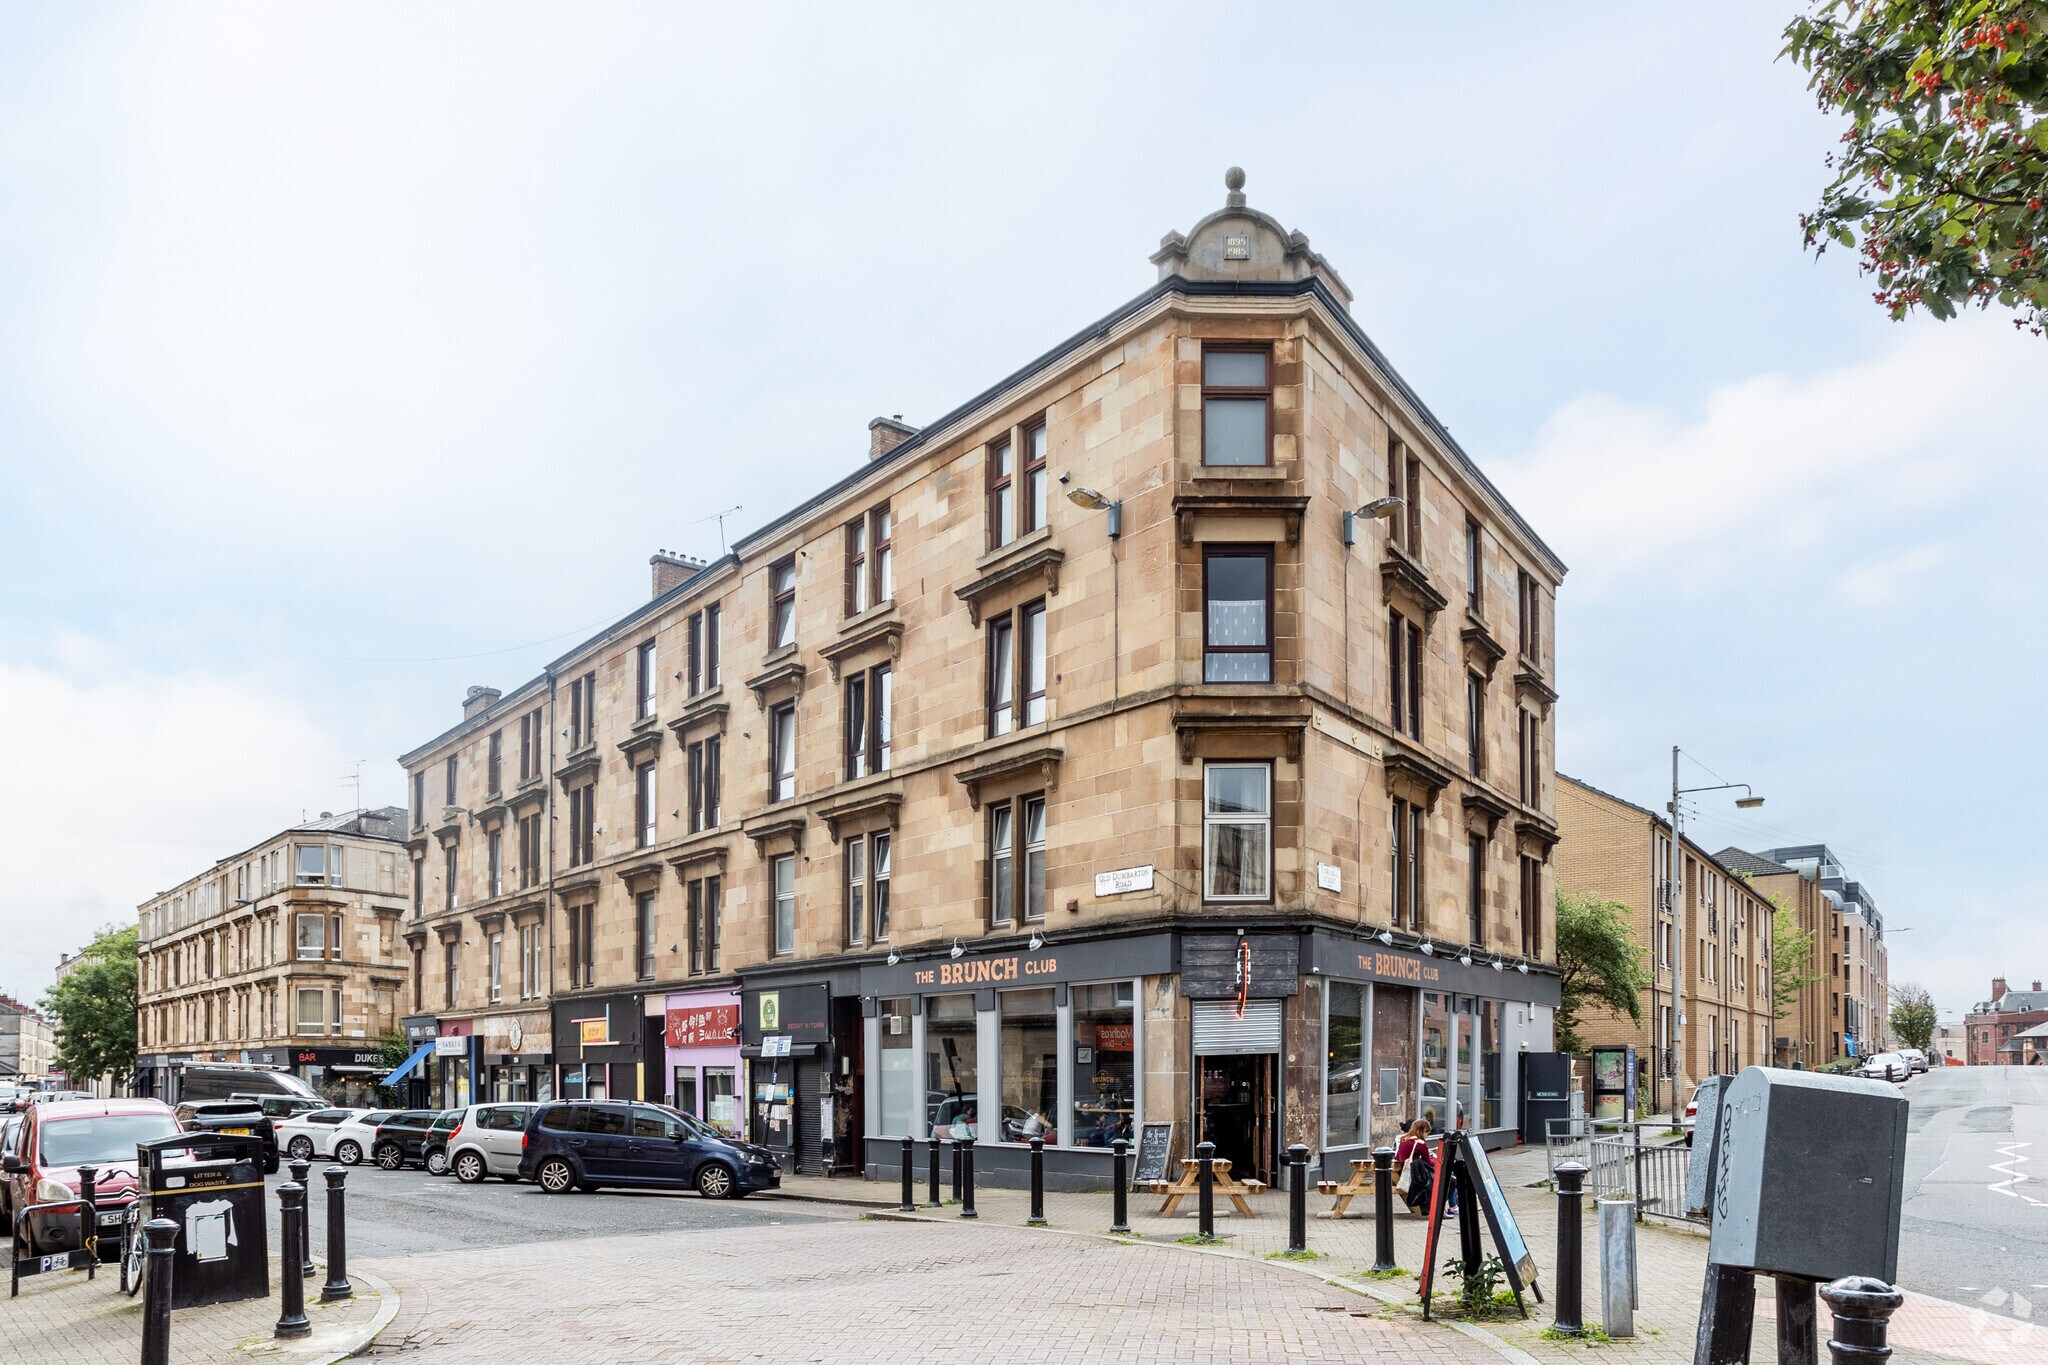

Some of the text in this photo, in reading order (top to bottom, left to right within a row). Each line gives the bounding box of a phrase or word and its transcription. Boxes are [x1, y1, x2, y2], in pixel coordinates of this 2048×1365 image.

[1227, 238, 1246, 246] 1895
[1227, 247, 1246, 255] 1985
[1098, 869, 1150, 883] OLD DUMBARTON
[1115, 880, 1132, 889] ROAD
[915, 957, 1057, 985] THE BRUNCH CLUB
[1357, 953, 1439, 981] THE BRUNCH CLUB
[299, 1053, 316, 1062] BAR
[43, 1257, 50, 1272] P
